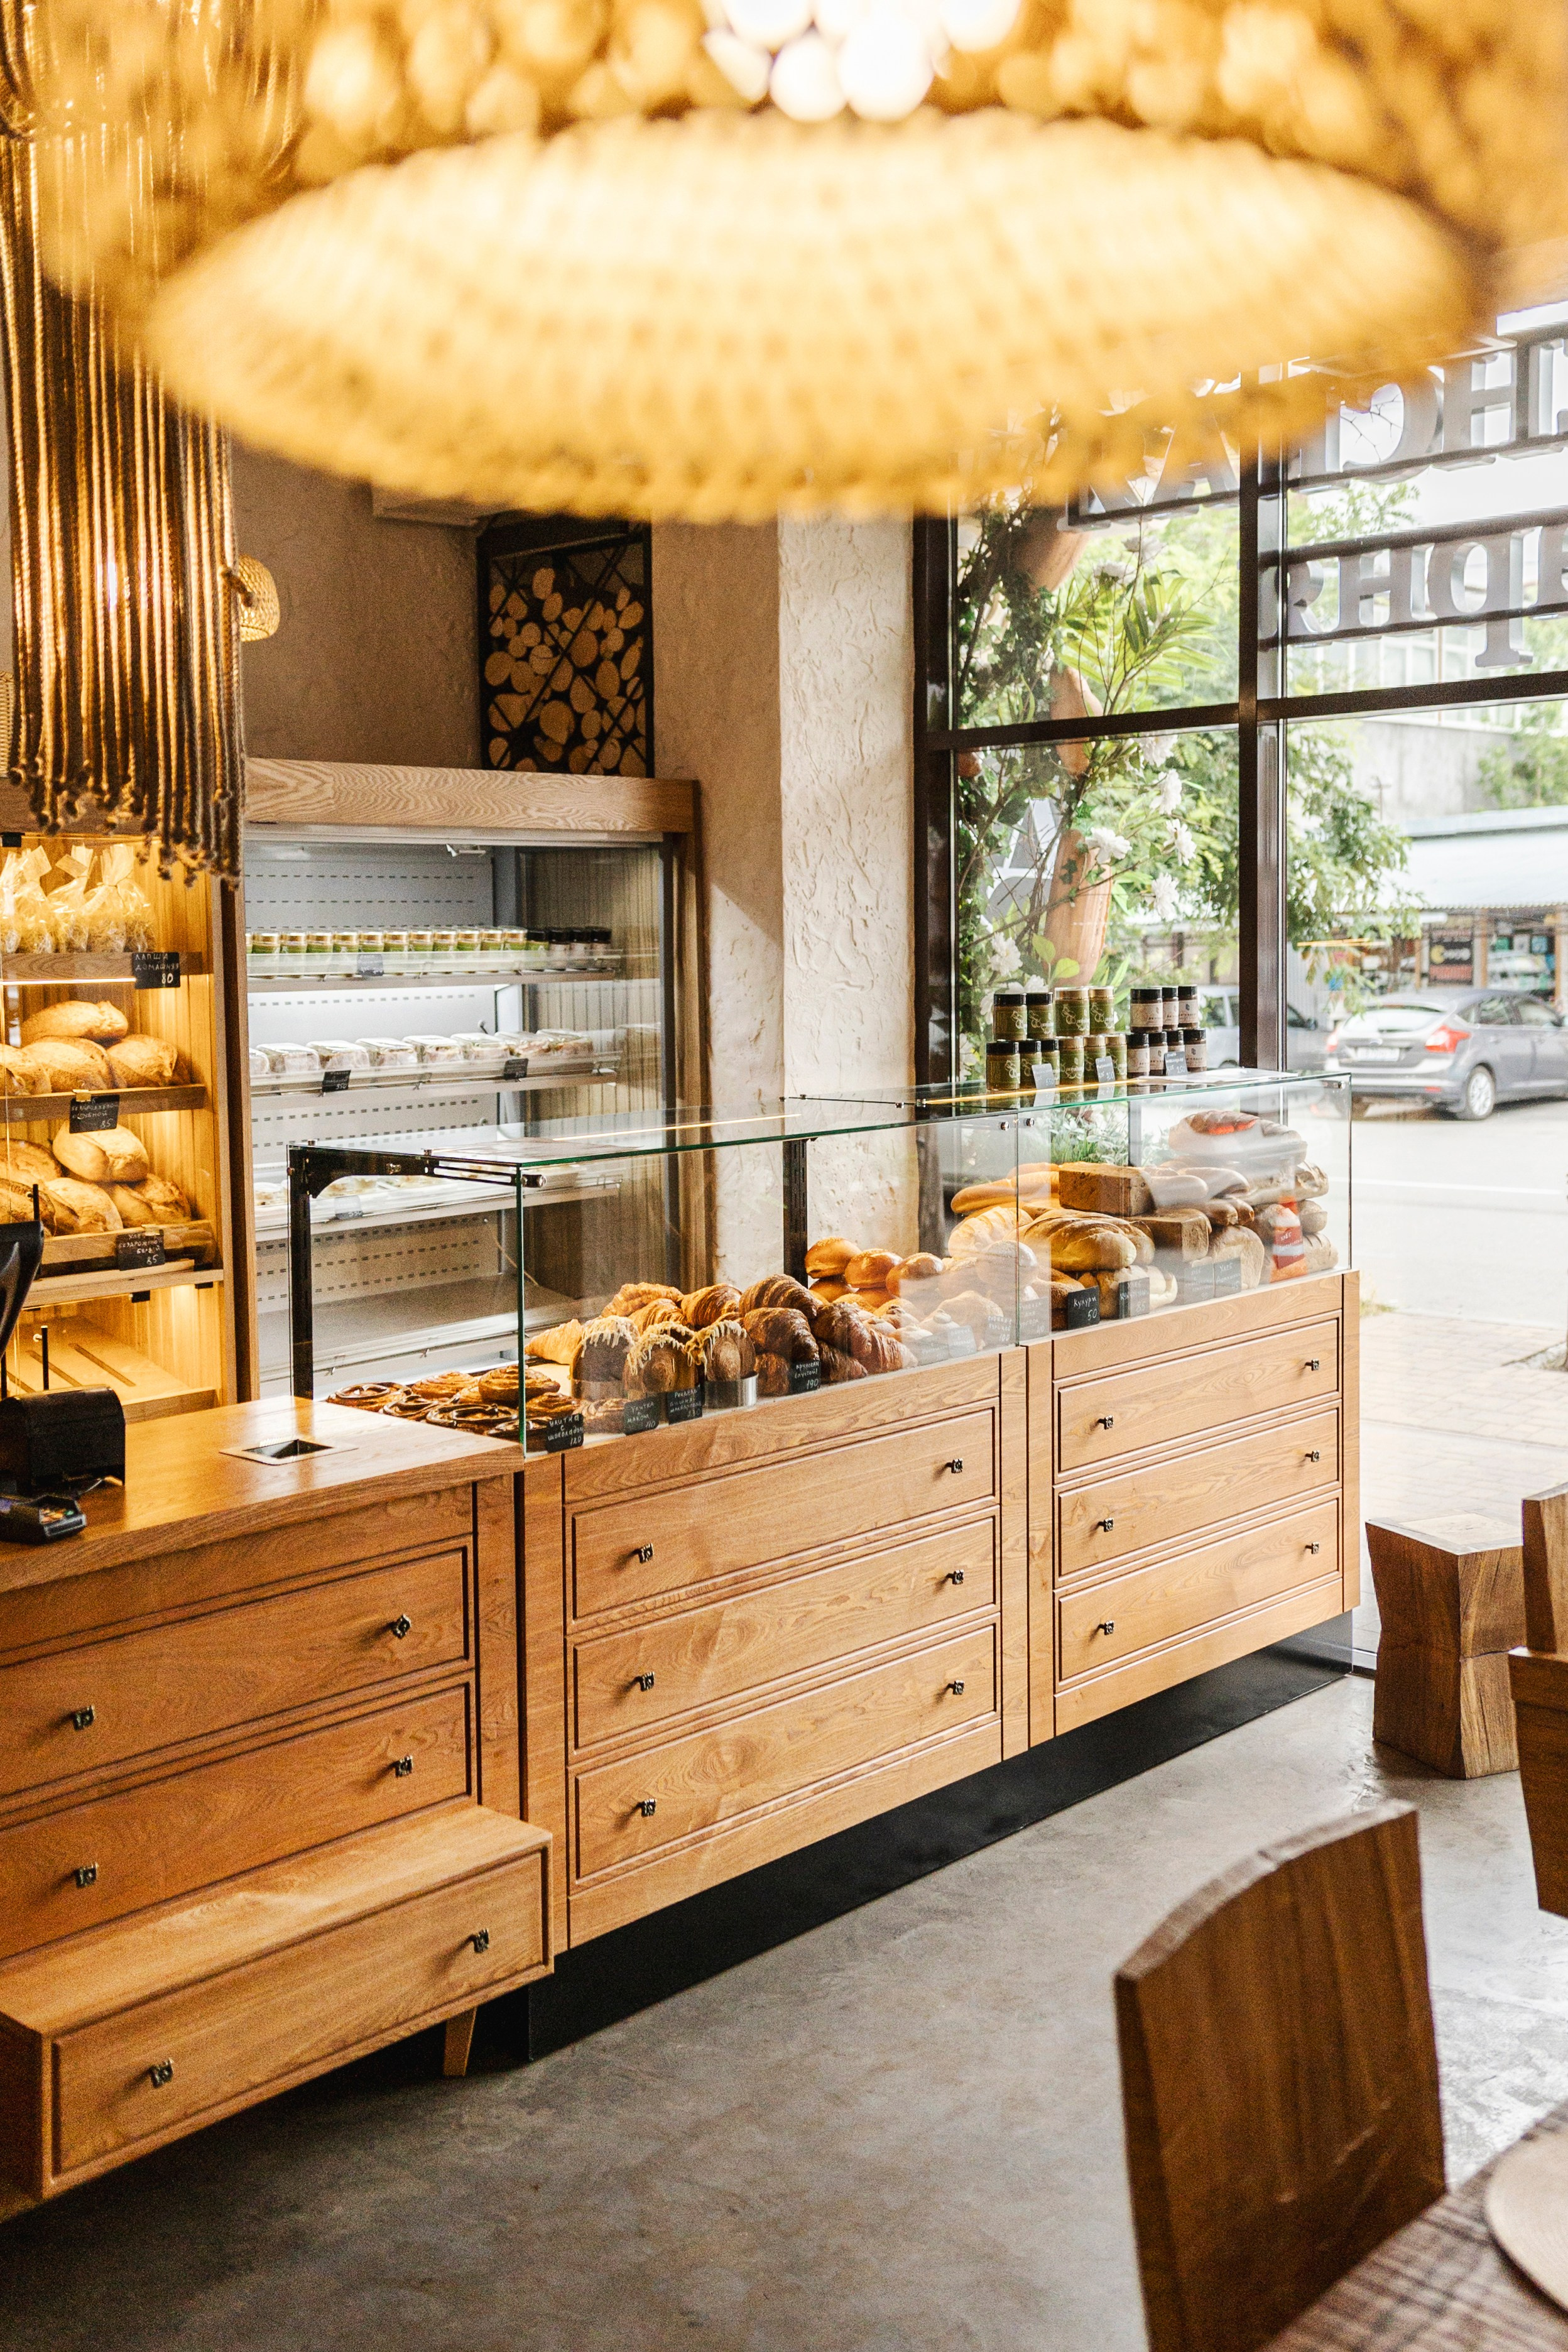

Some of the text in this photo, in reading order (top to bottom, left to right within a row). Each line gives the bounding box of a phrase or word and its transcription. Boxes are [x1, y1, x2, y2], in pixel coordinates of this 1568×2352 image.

[161, 972, 173, 984] 80
[101, 1118, 114, 1129] 85
[146, 1254, 158, 1265] 85
[1074, 1296, 1097, 1309] Кулури
[1087, 1308, 1097, 1321] 50
[807, 1378, 819, 1390] 190
